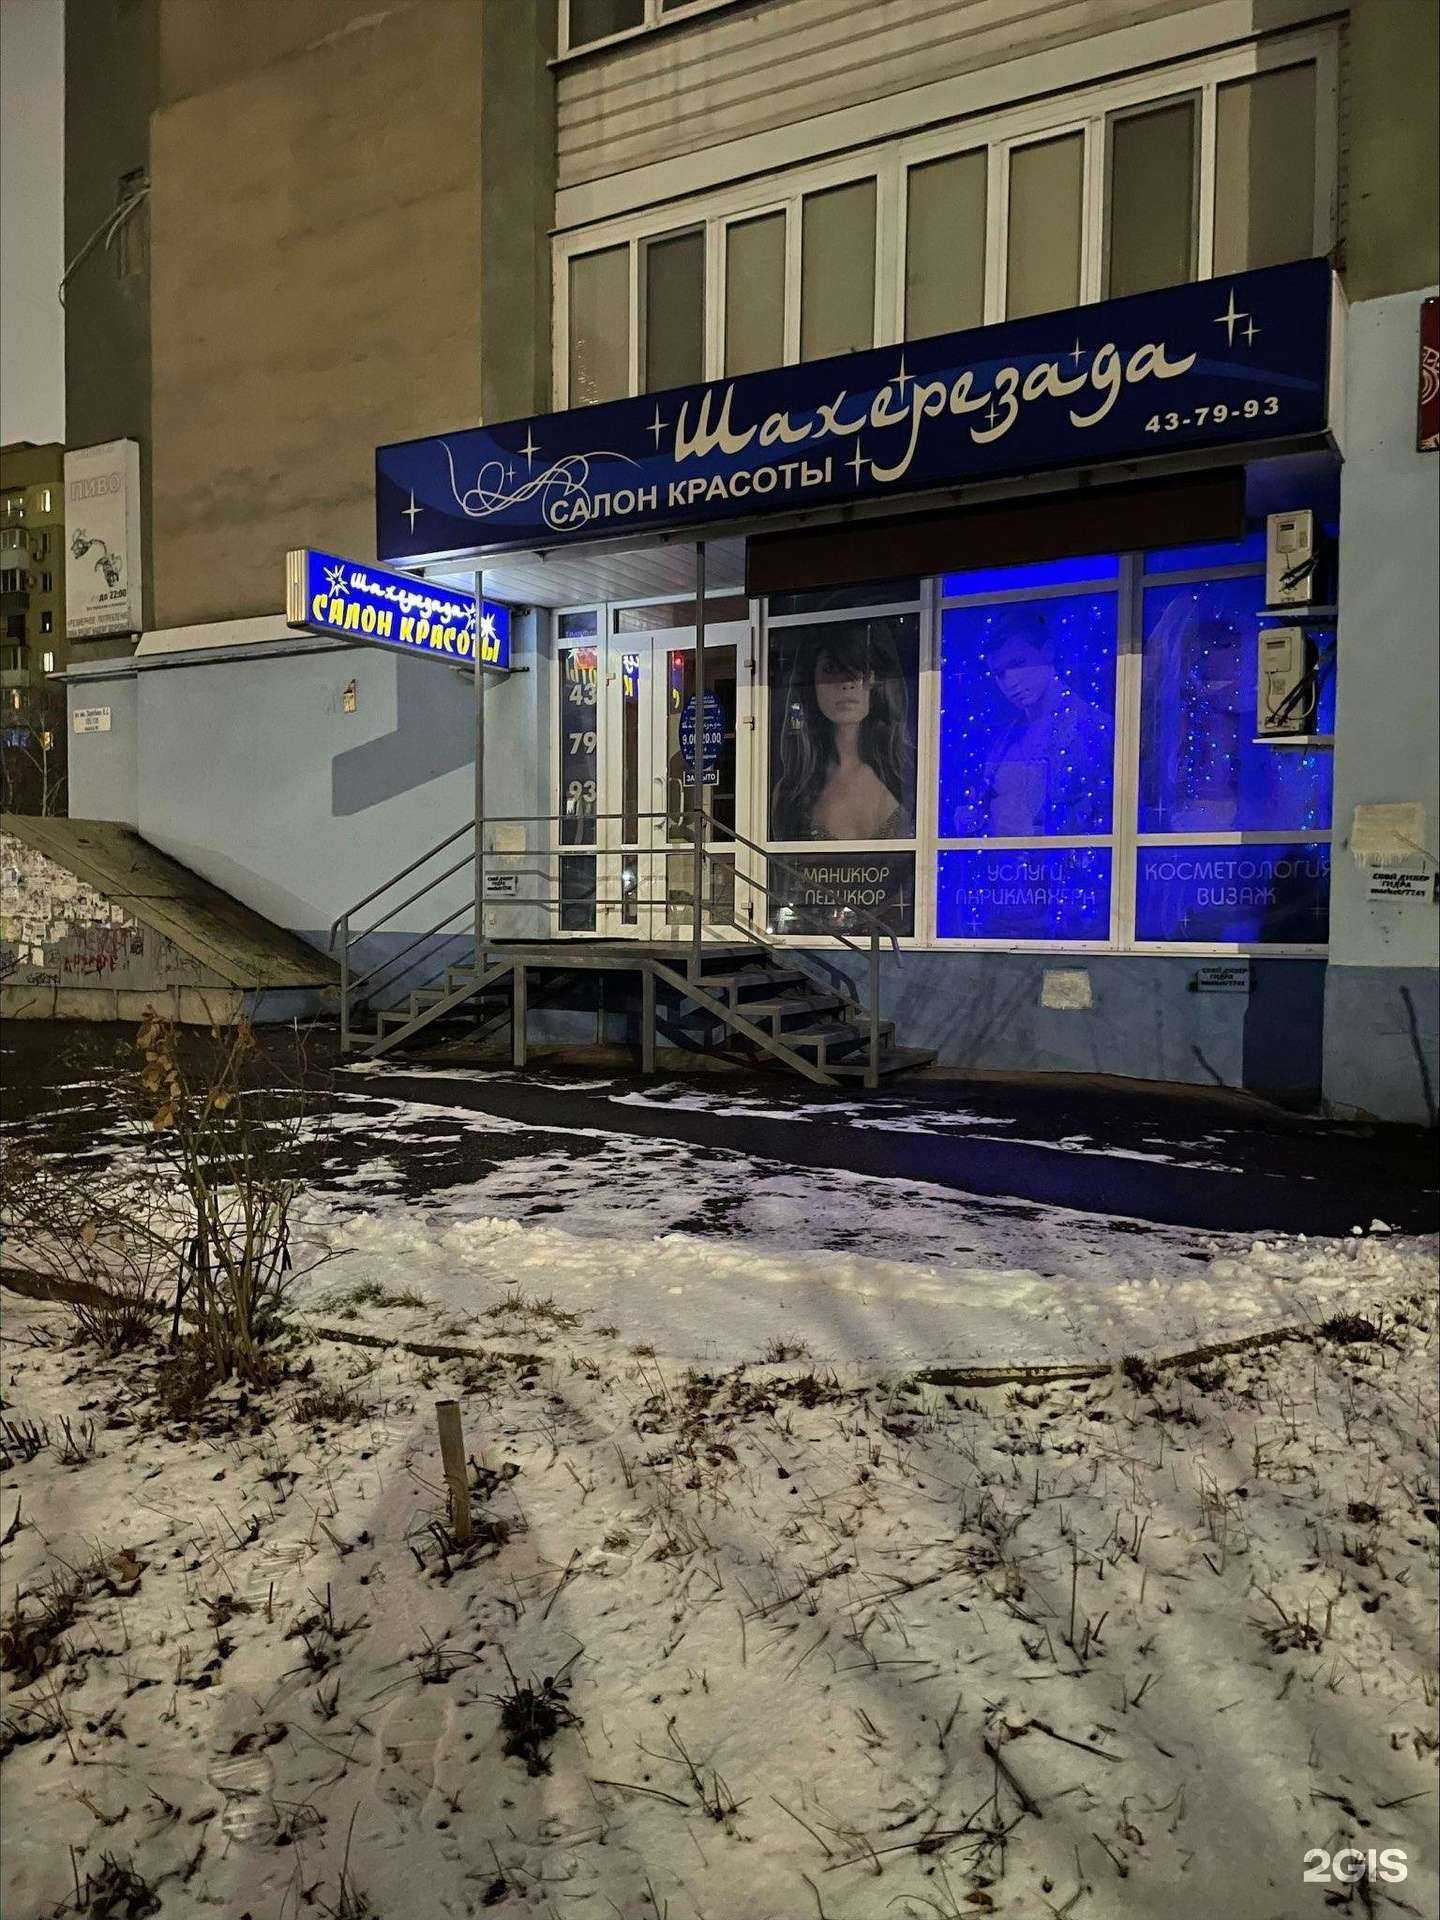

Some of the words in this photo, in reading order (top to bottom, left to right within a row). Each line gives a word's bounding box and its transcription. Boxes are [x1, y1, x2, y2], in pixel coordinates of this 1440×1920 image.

[674, 342, 1197, 482] Шахерезада
[1145, 397, 1280, 433] 43-79-93
[70, 471, 122, 503] ПИВО
[550, 486, 658, 526] САЛОН
[668, 457, 832, 507] КРАСОТЫ
[110, 589, 127, 600] 22:00
[312, 593, 393, 638] САЛОН
[569, 683, 597, 706] 43
[569, 731, 597, 755] 79
[568, 780, 597, 802] 93
[802, 867, 890, 883] МАНИКЮР
[987, 864, 1063, 881] УСЛУГИ
[1196, 887, 1277, 906] ВИЗАЖ
